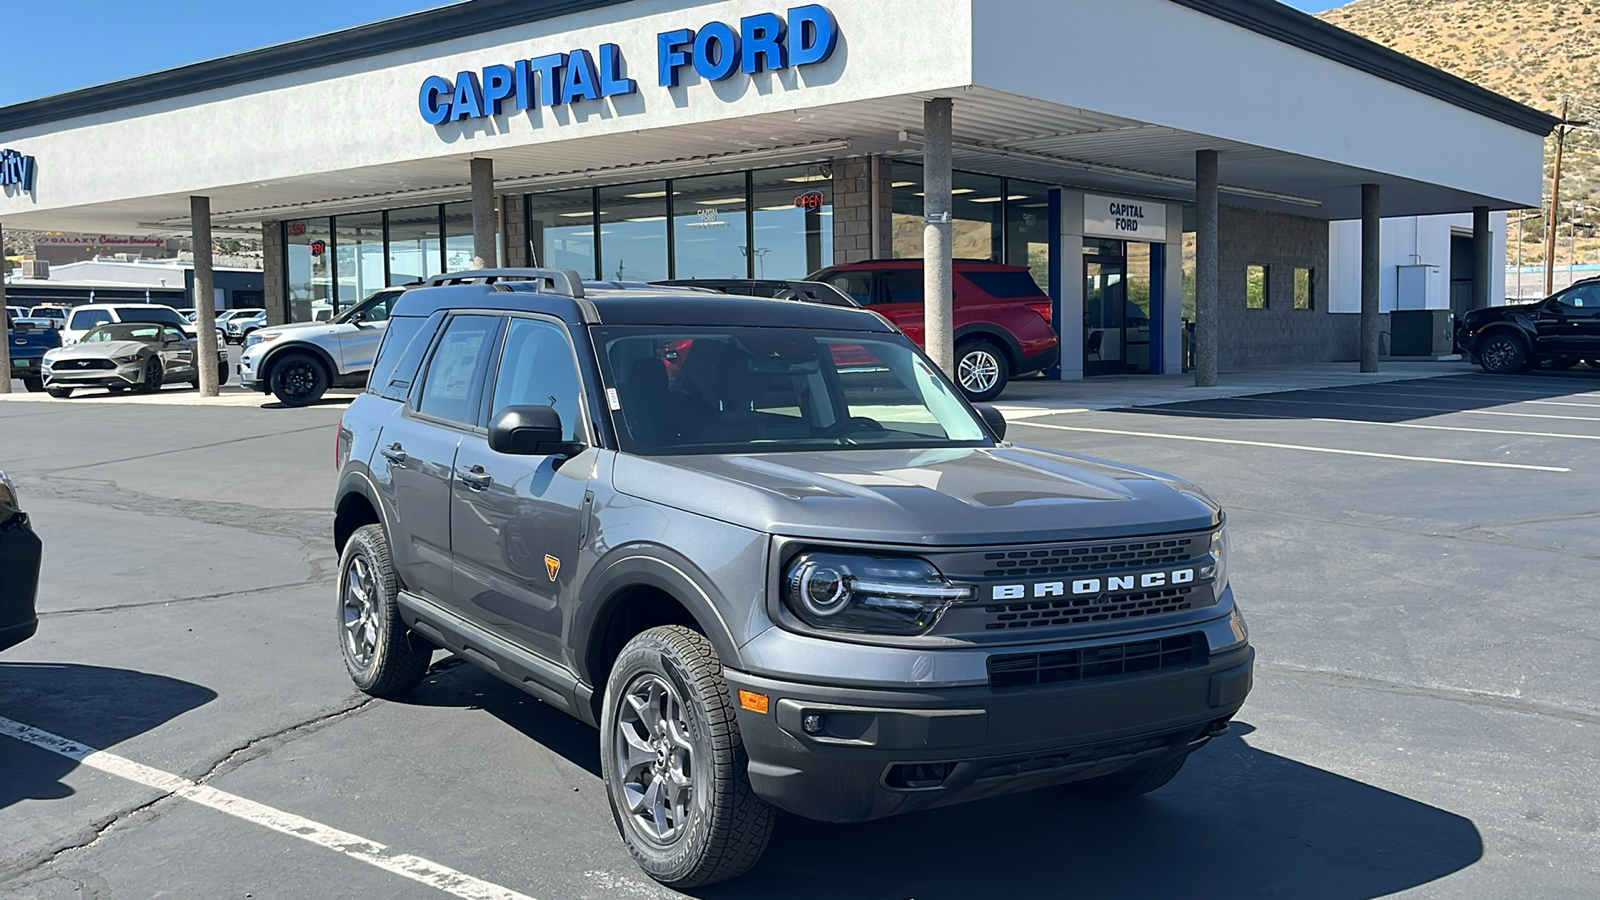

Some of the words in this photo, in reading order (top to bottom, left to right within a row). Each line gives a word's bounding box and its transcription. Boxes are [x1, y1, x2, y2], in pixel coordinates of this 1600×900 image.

[418, 43, 636, 126] CAPITAL
[658, 3, 839, 87] FORD
[793, 193, 824, 208] OPEN
[1109, 202, 1144, 218] CAPITAL
[1115, 218, 1138, 231] FORD
[992, 568, 1194, 600] BRONCO
